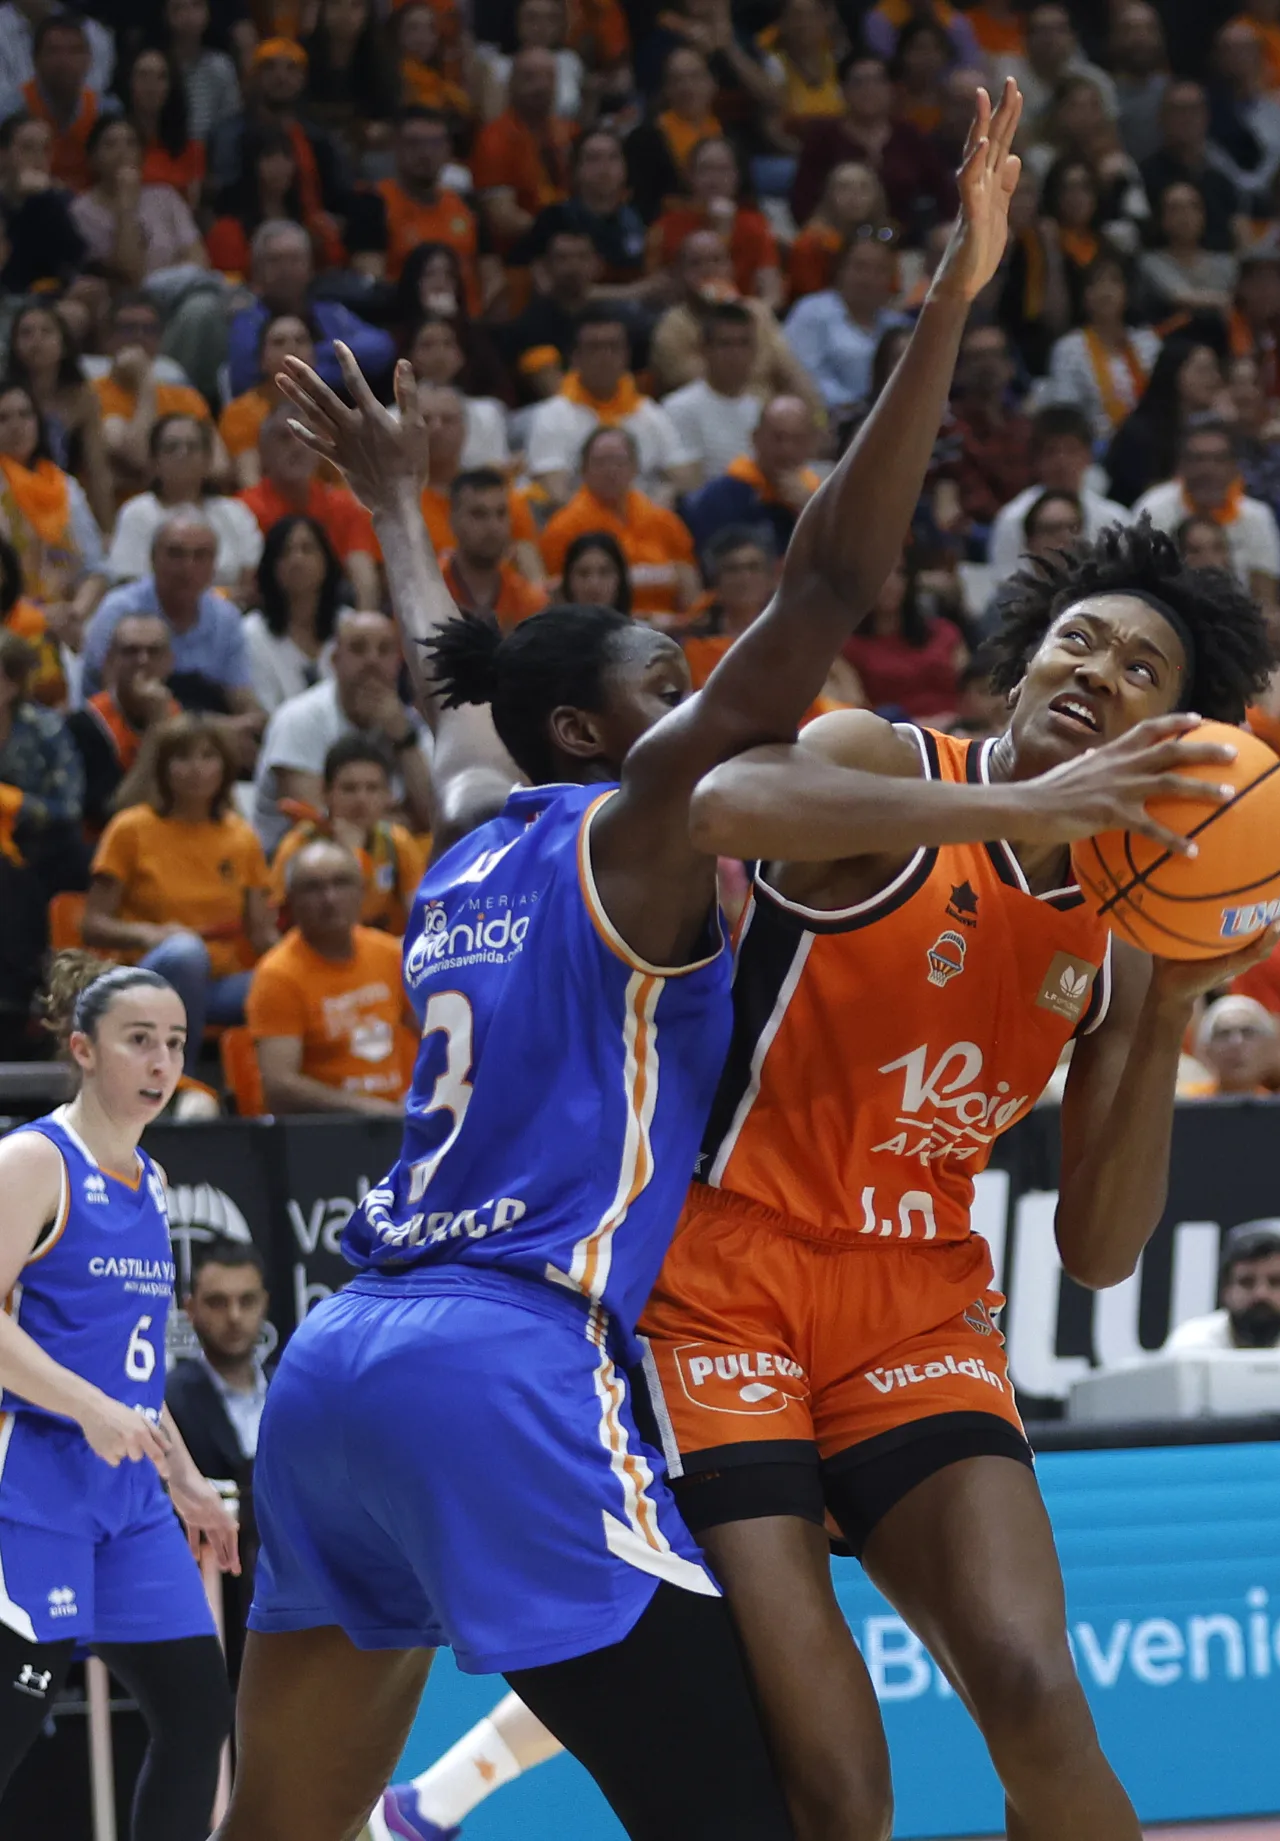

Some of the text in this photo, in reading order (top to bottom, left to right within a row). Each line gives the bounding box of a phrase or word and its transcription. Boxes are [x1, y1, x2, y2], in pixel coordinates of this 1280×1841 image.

[408, 990, 473, 1204] 3
[89, 1256, 161, 1280] CASTILLA
[124, 1316, 156, 1382] 6
[864, 1354, 1005, 1394] Vitaldin
